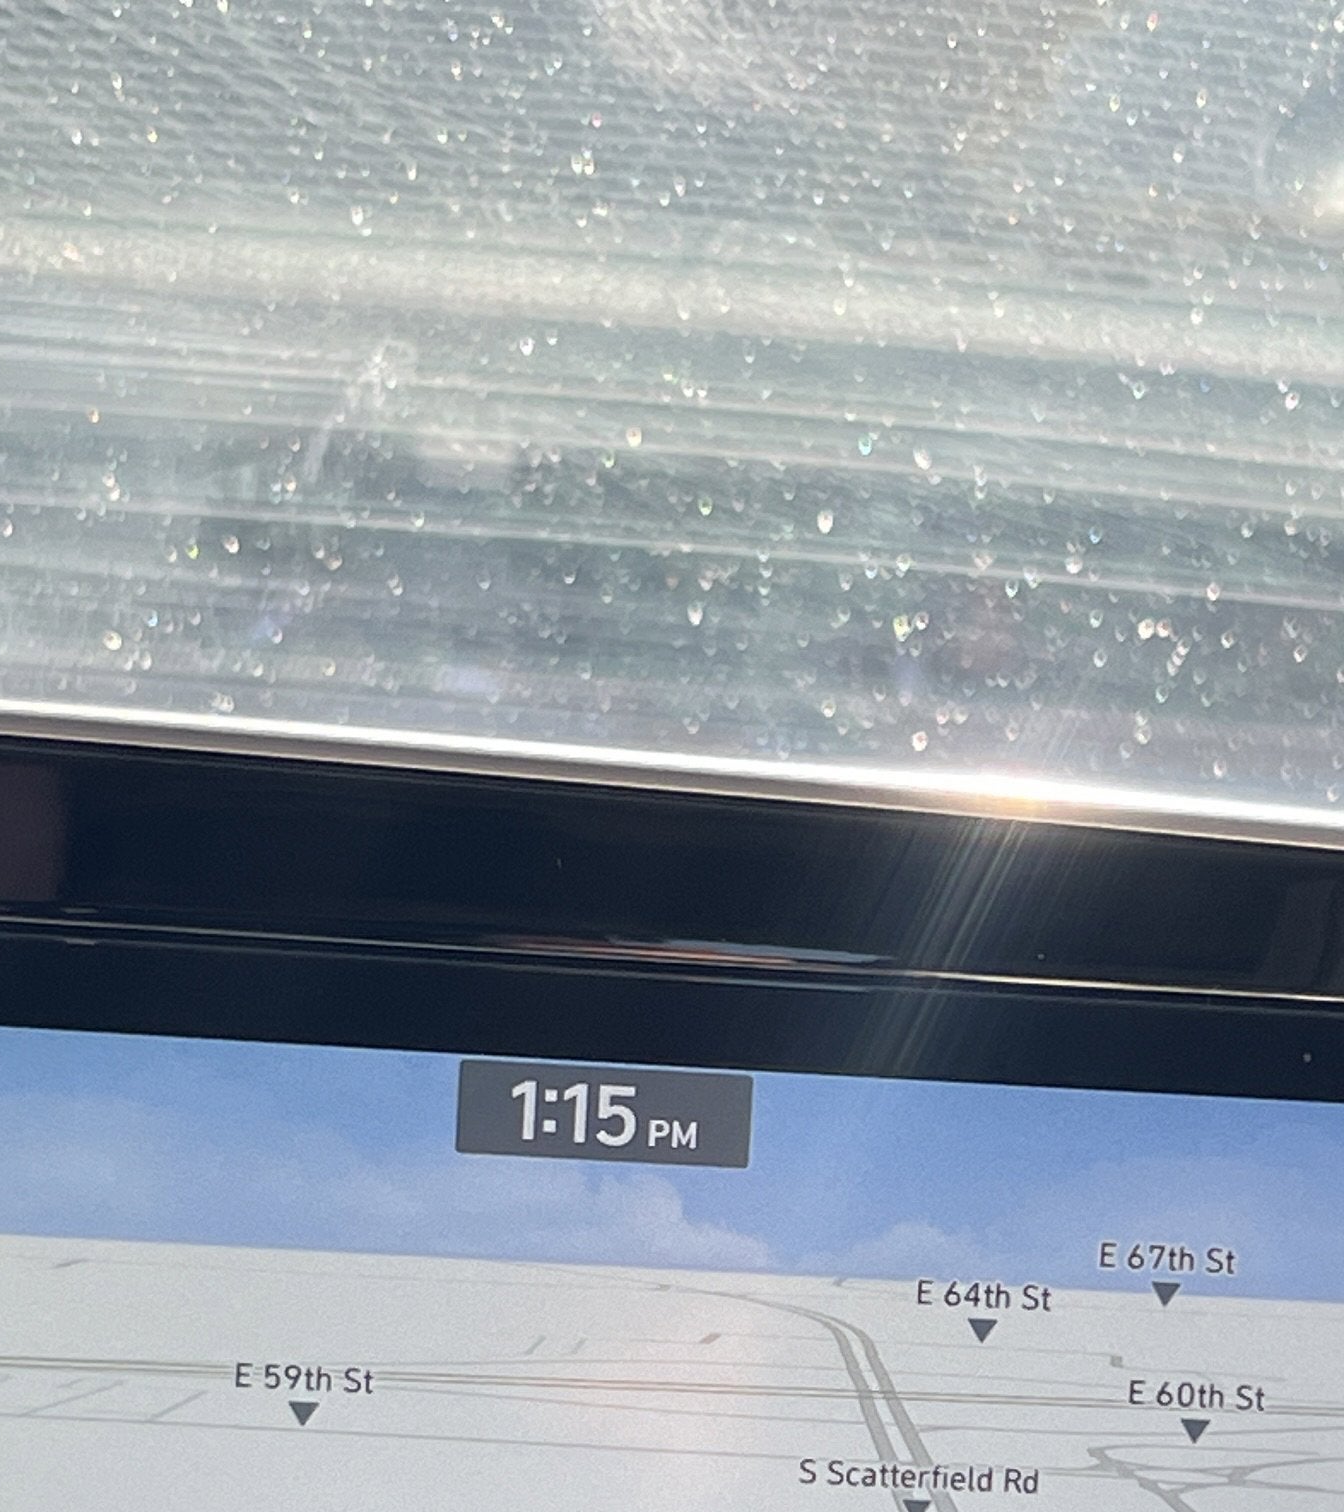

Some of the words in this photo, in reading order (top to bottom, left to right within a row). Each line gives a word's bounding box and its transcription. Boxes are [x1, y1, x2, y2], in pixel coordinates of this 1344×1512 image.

[510, 1079, 638, 1149] 1:15
[647, 1119, 698, 1150] PM
[1099, 1242, 1116, 1268] E
[1127, 1244, 1195, 1272] 67th
[1205, 1248, 1236, 1275] St
[916, 1279, 933, 1305] E
[944, 1281, 1011, 1309] 64th
[1022, 1285, 1052, 1312] St
[234, 1363, 251, 1389] E
[263, 1364, 332, 1393] 59th
[343, 1367, 375, 1395] St
[1128, 1380, 1145, 1406] E
[1156, 1381, 1225, 1409] 60th
[1236, 1385, 1265, 1411] St
[798, 1459, 817, 1485] S
[827, 1461, 993, 1493] Scatterfield
[1004, 1468, 1039, 1495] Rd
